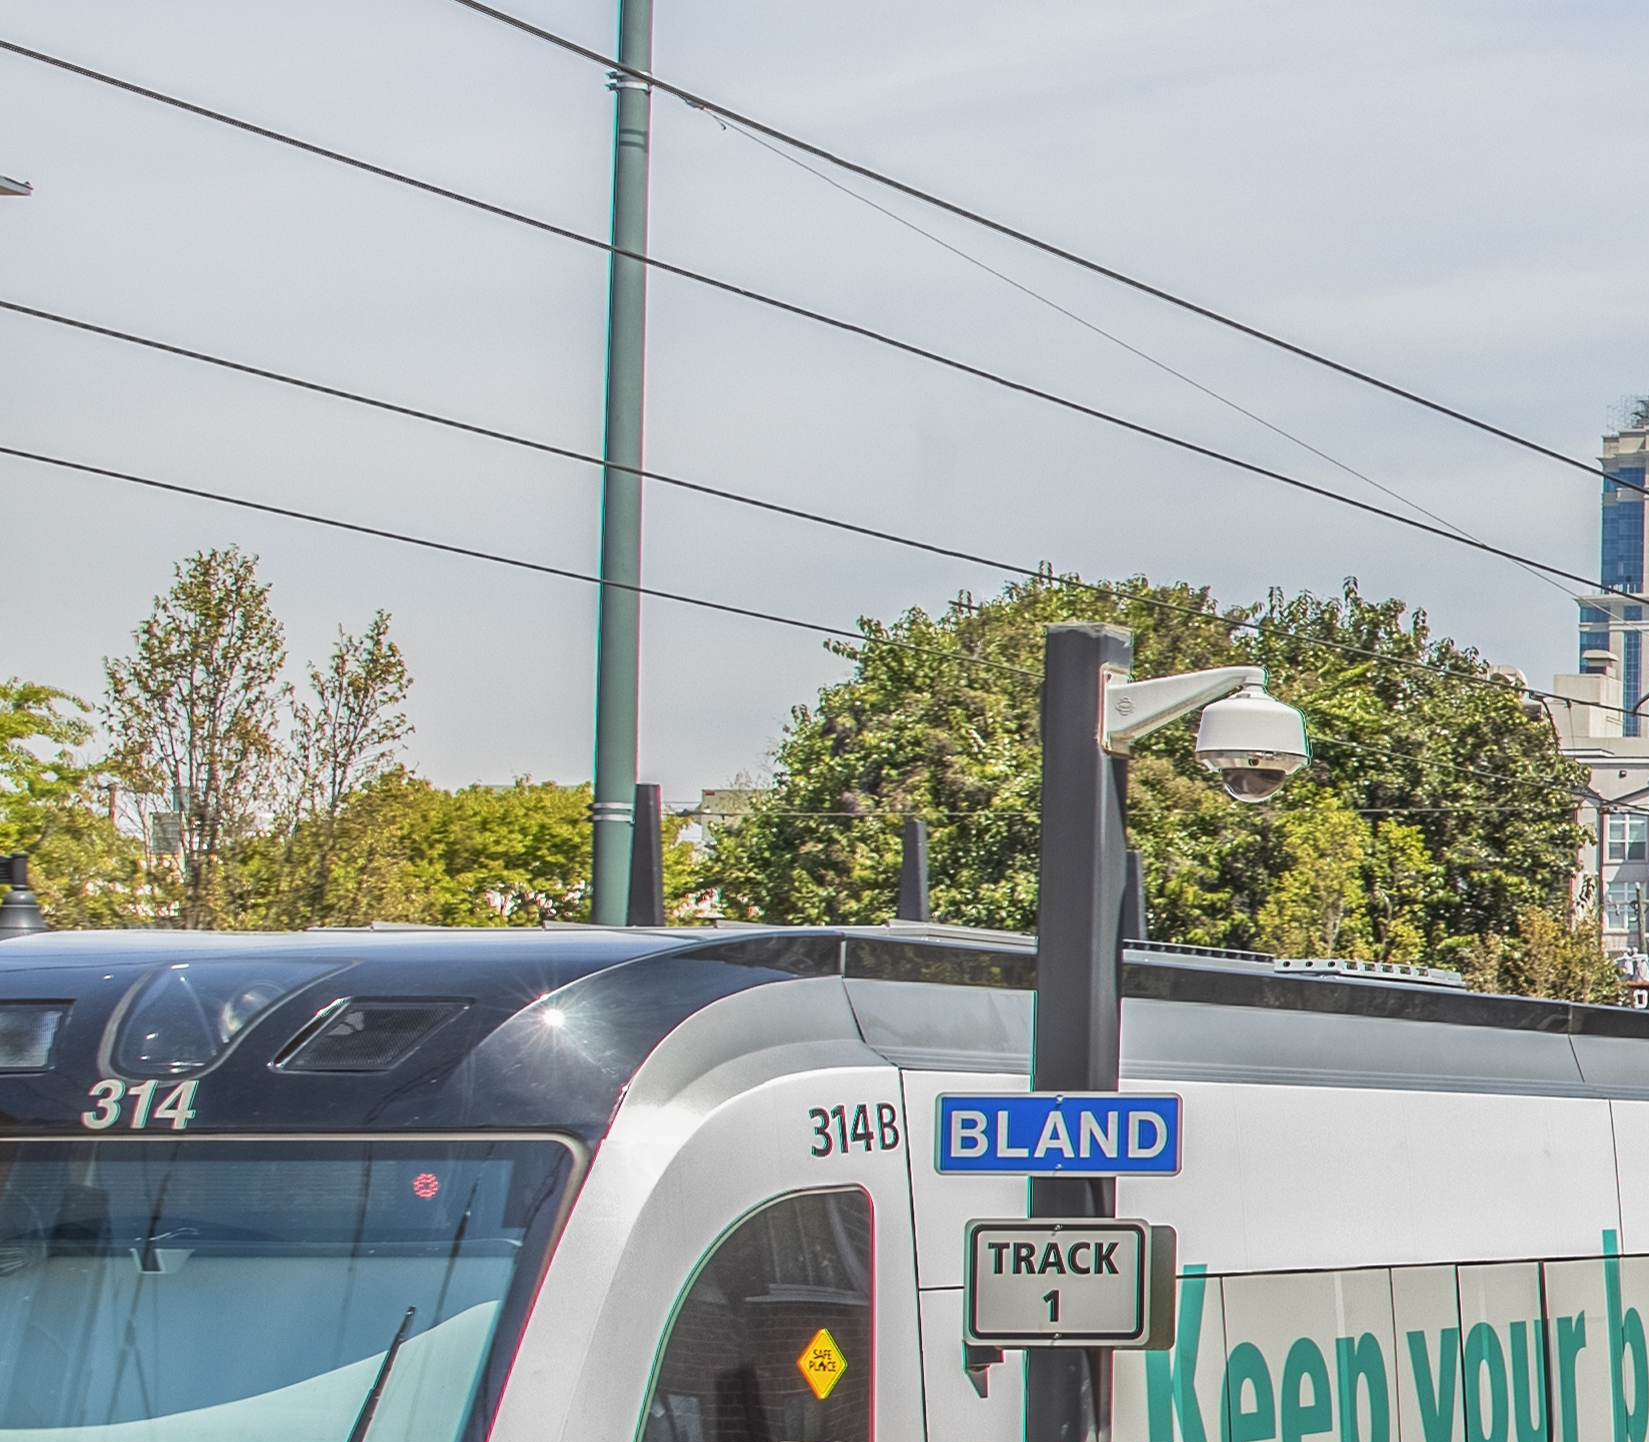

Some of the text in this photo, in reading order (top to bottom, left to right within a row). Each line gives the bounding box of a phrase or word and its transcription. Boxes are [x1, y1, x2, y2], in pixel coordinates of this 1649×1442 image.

[80, 1078, 199, 1130] 314
[808, 1103, 900, 1158] 314B
[949, 1110, 1169, 1159] BLAND
[988, 1241, 1119, 1275] TRACK
[1042, 1289, 1060, 1322] 1
[813, 1349, 832, 1360] SAFE
